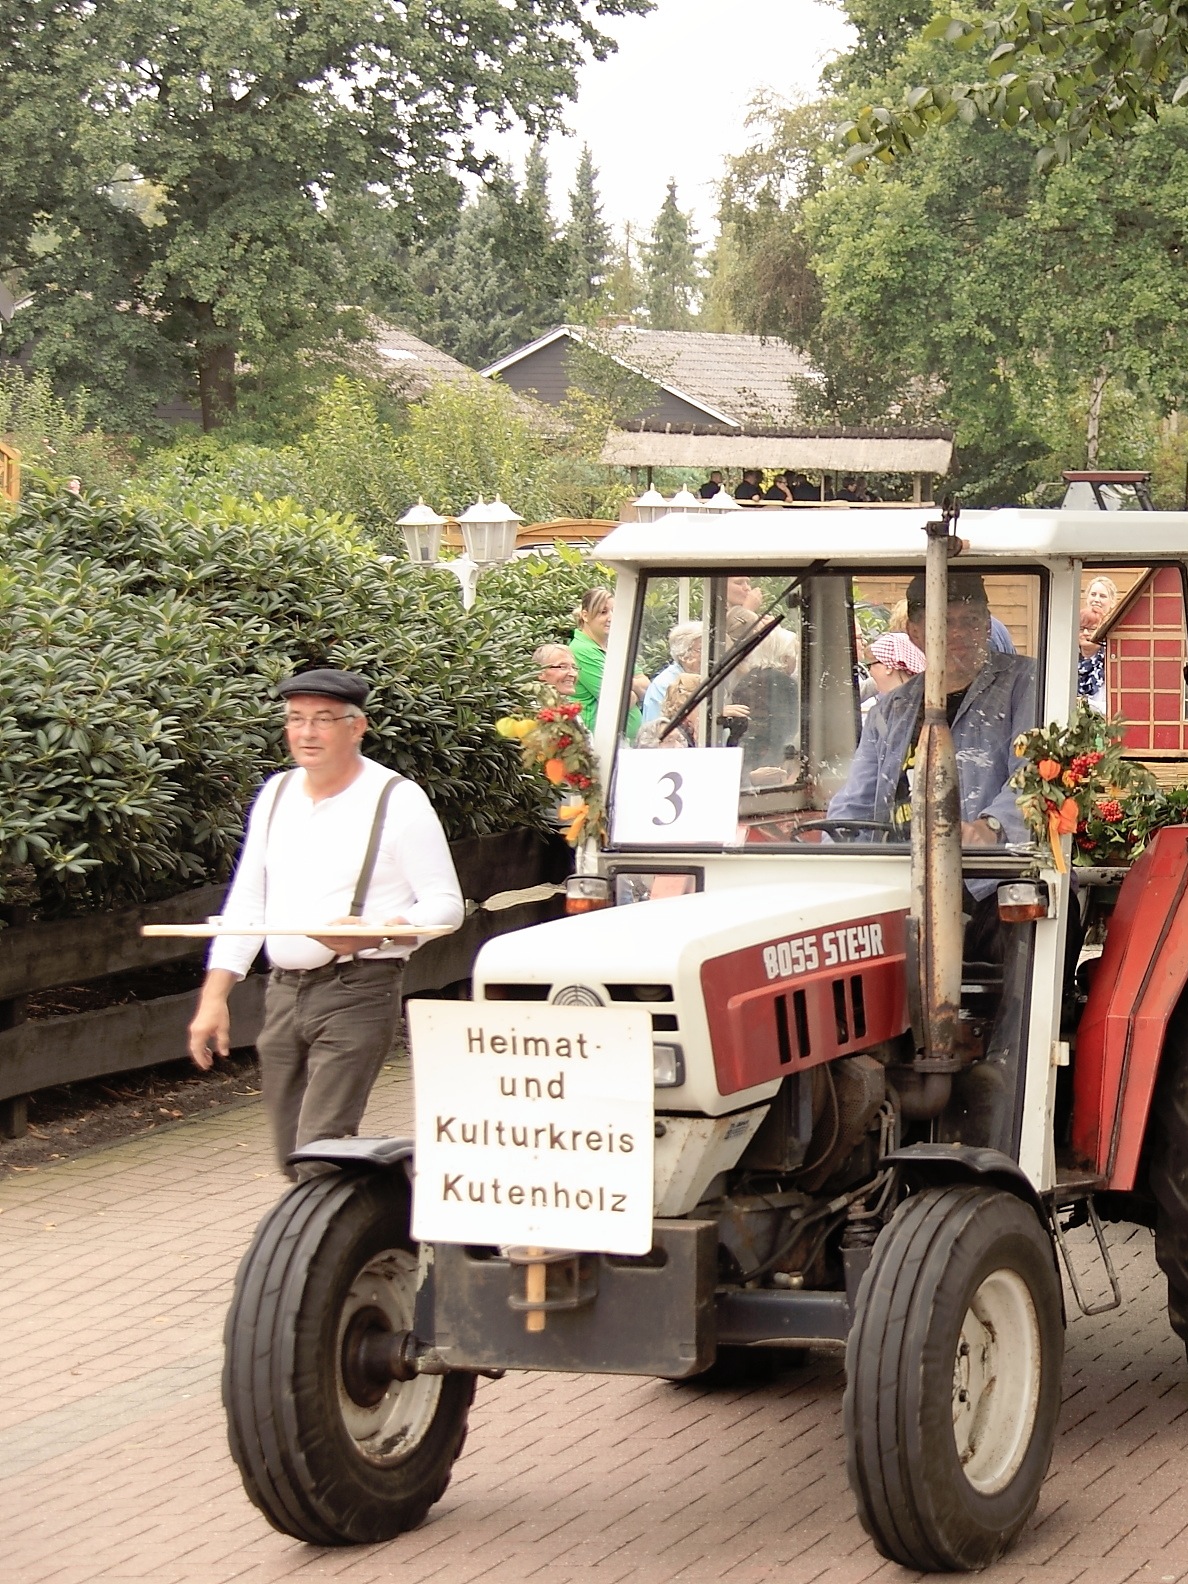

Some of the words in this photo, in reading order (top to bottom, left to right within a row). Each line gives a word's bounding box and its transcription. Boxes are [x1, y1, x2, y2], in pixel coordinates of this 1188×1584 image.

[652, 771, 683, 826] 3
[822, 923, 885, 966] STEYR
[467, 1026, 601, 1059] Heimat-
[500, 1071, 565, 1100] und
[436, 1115, 634, 1153] Kulturkreis
[442, 1173, 628, 1213] Kutenholz
